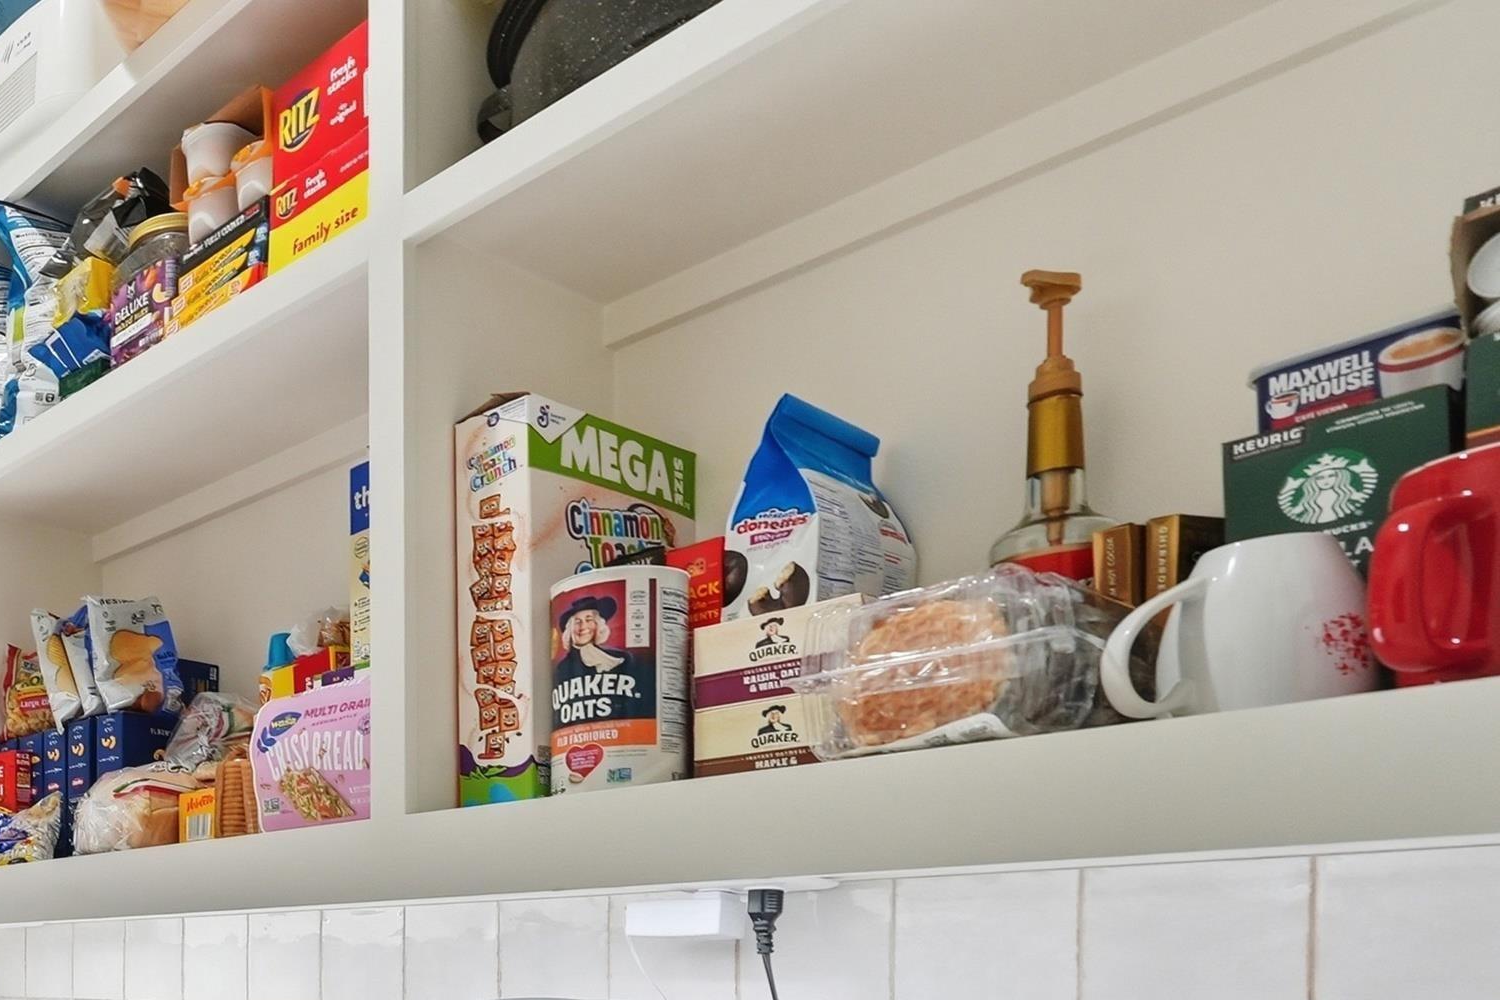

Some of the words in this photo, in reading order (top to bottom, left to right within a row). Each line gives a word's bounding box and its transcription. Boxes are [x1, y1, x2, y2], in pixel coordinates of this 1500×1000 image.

[279, 87, 320, 148] RITZ
[276, 188, 298, 217] RITZ
[293, 223, 330, 255] family
[335, 206, 358, 229] size
[115, 292, 150, 325] DELUXE
[1268, 350, 1374, 397] MAXWELL
[1300, 368, 1375, 405] HOUSE
[468, 434, 516, 470] Cinnamon
[1232, 427, 1302, 456] KEURIG
[470, 457, 517, 492] Crunch
[560, 424, 673, 502] MEGA
[354, 485, 370, 510] th
[673, 457, 684, 506] SIZE
[567, 498, 664, 541] Cinnamon
[1157, 526, 1168, 590] GHIRARDE
[690, 580, 720, 598] ACK
[749, 644, 798, 662] QUAKER
[759, 680, 783, 692] WAL
[781, 667, 801, 679] DAT
[552, 673, 636, 711] QUAKER
[304, 703, 337, 719] MULTI
[560, 698, 612, 723] OATS
[751, 732, 799, 749] QUAKER
